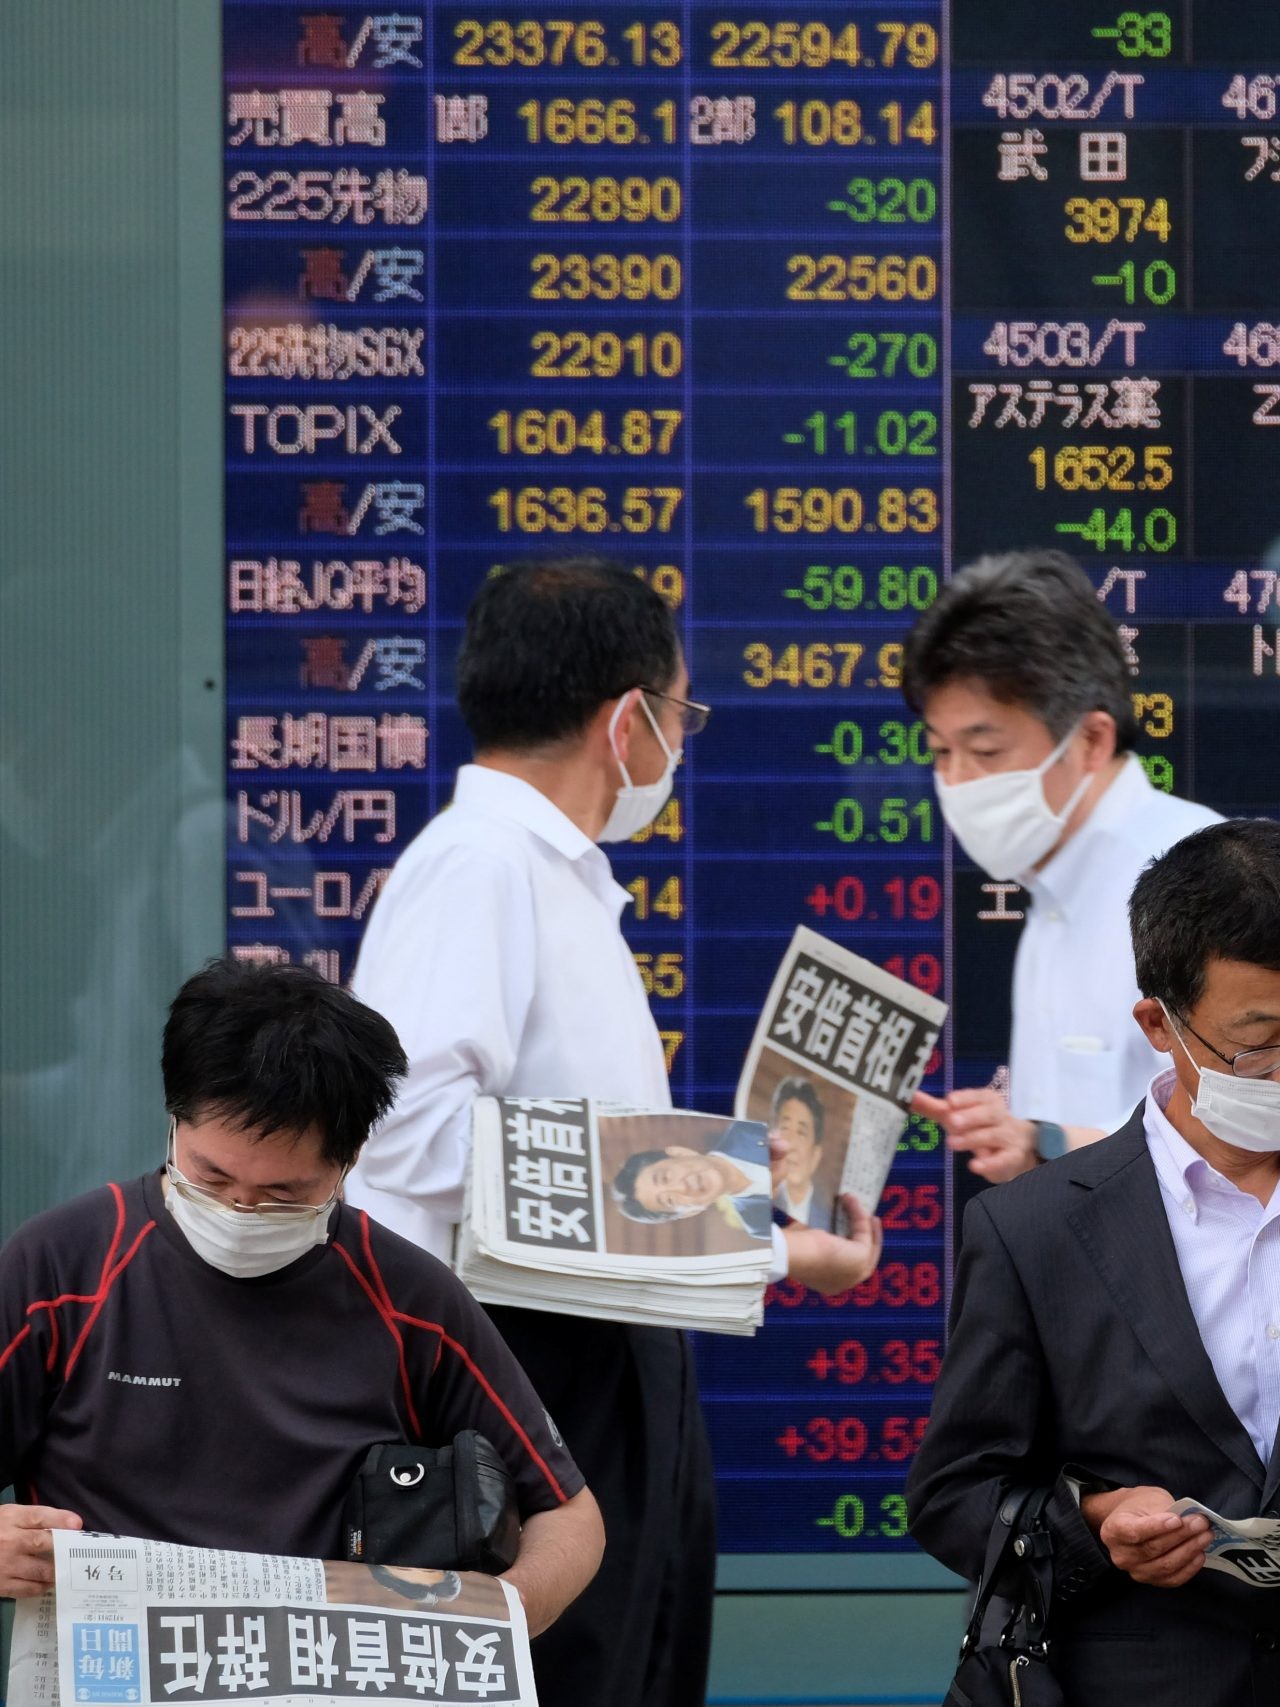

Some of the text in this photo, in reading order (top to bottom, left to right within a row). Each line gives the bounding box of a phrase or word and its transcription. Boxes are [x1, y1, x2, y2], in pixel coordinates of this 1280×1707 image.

[456, 21, 683, 66] 23376.13
[712, 22, 938, 68] 22594.79
[1094, 13, 1171, 56] -33
[983, 71, 1144, 118] 4502/T
[229, 89, 385, 146] 売買高
[520, 99, 676, 144] 1666.1
[776, 101, 936, 145] 108.14
[230, 169, 935, 224] 225先物 22890 -320
[1065, 198, 1171, 242] 3974
[532, 255, 681, 299] 23390
[787, 255, 936, 300] 22560
[1093, 261, 1175, 304] -10
[532, 332, 682, 377] 22910
[831, 333, 936, 377] -270
[984, 319, 1145, 366] 4503/T
[232, 406, 936, 455] TOPIX 1604.87 -11.02
[1029, 446, 1172, 490] 1652.5
[491, 488, 682, 532] 1636.57
[747, 488, 939, 532] 1590.83
[1056, 509, 1176, 551] -44.0
[786, 566, 937, 609] -59.80
[233, 713, 426, 771] 長期国債
[817, 799, 936, 841] -0.51
[810, 877, 940, 919] +0.19
[107, 1371, 182, 1387] MAMMUT
[810, 1341, 940, 1382] +9.35
[159, 1613, 508, 1699] 安倍首相辞任
